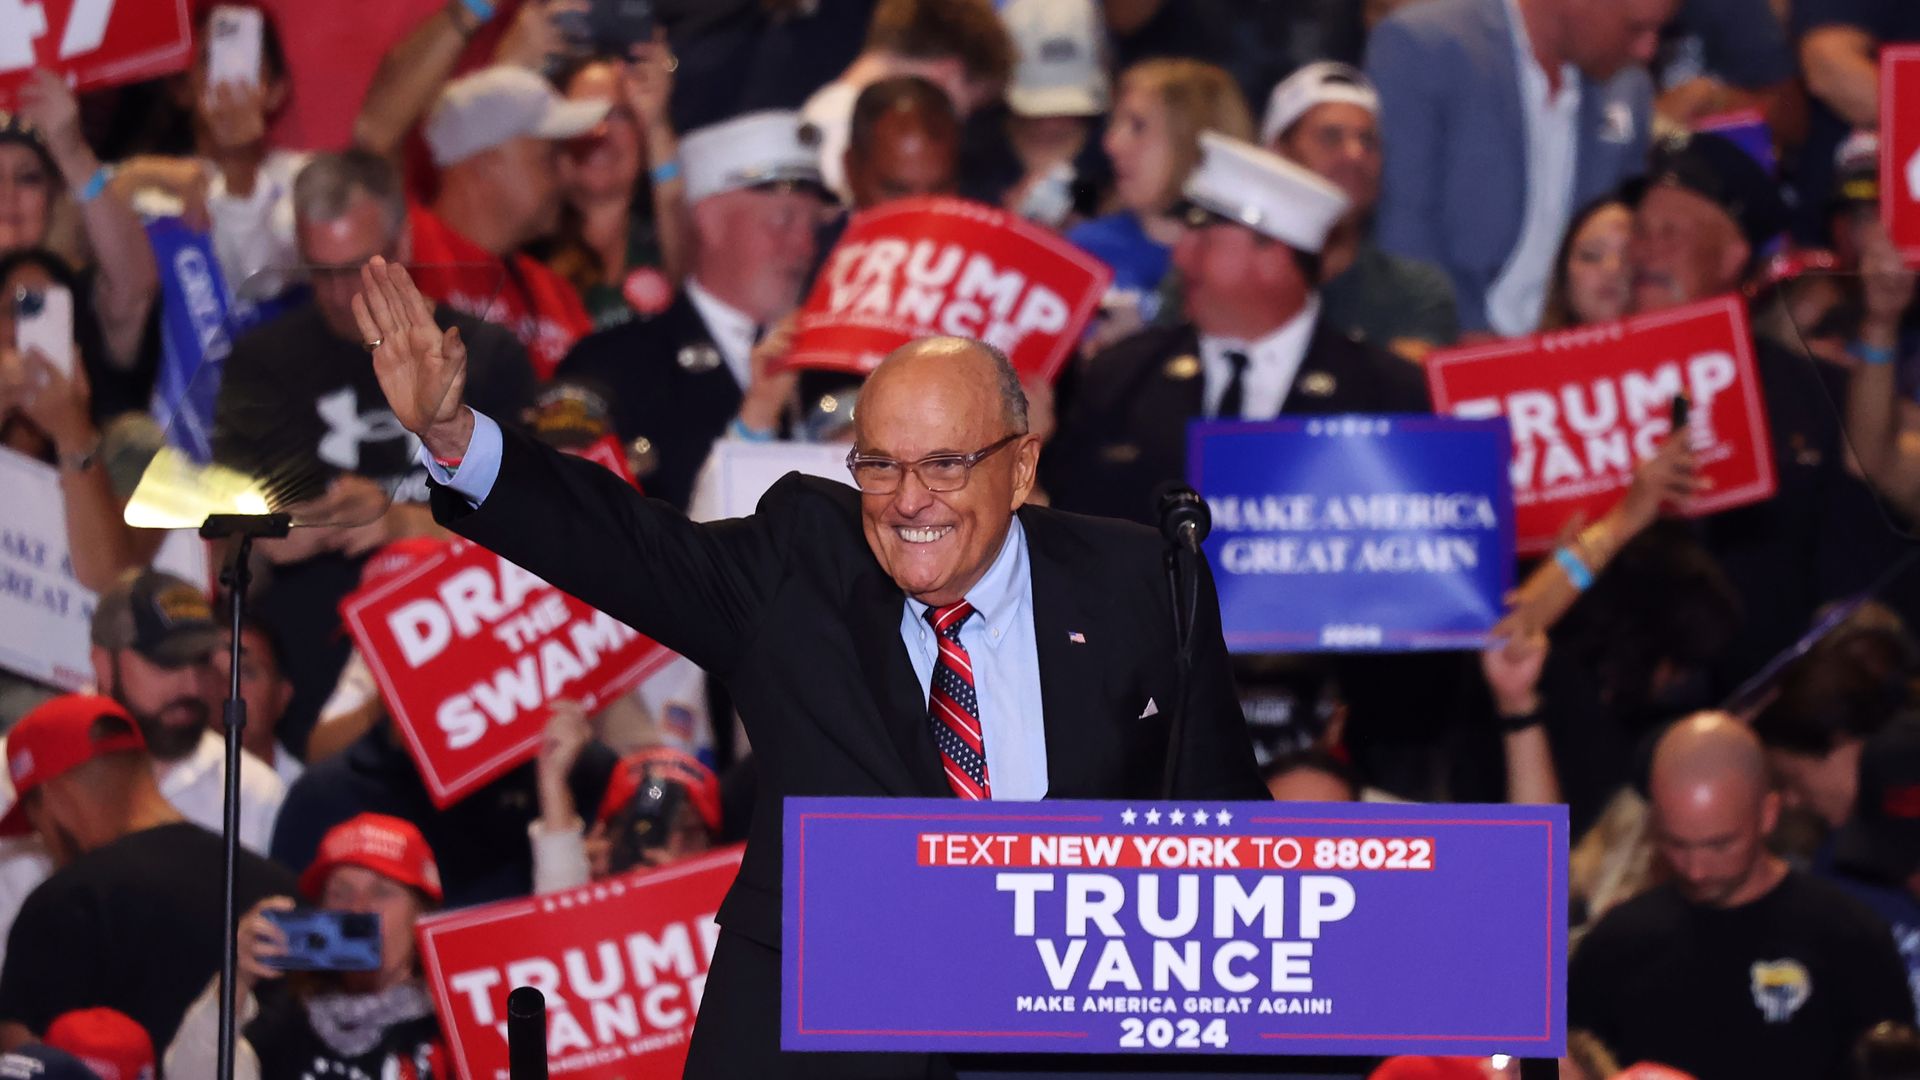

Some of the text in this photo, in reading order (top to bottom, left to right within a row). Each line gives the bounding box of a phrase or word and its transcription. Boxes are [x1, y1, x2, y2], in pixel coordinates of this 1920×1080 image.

[831, 238, 1069, 336] TRUMP
[1209, 494, 1497, 532] MAKE AMERICA
[1220, 536, 1478, 575] GREAT AGAIN
[386, 555, 552, 669] DRA
[494, 593, 571, 652] THE
[922, 834, 1432, 870] TEXT NEW YORK TO 88022
[995, 873, 1356, 939] TRUMP
[1035, 938, 1314, 993] VANCE
[496, 974, 708, 1058] ANC
[1016, 996, 1333, 1015] MAKE AMERICA GREAT AGAIN!
[1119, 1017, 1229, 1048] 2024
